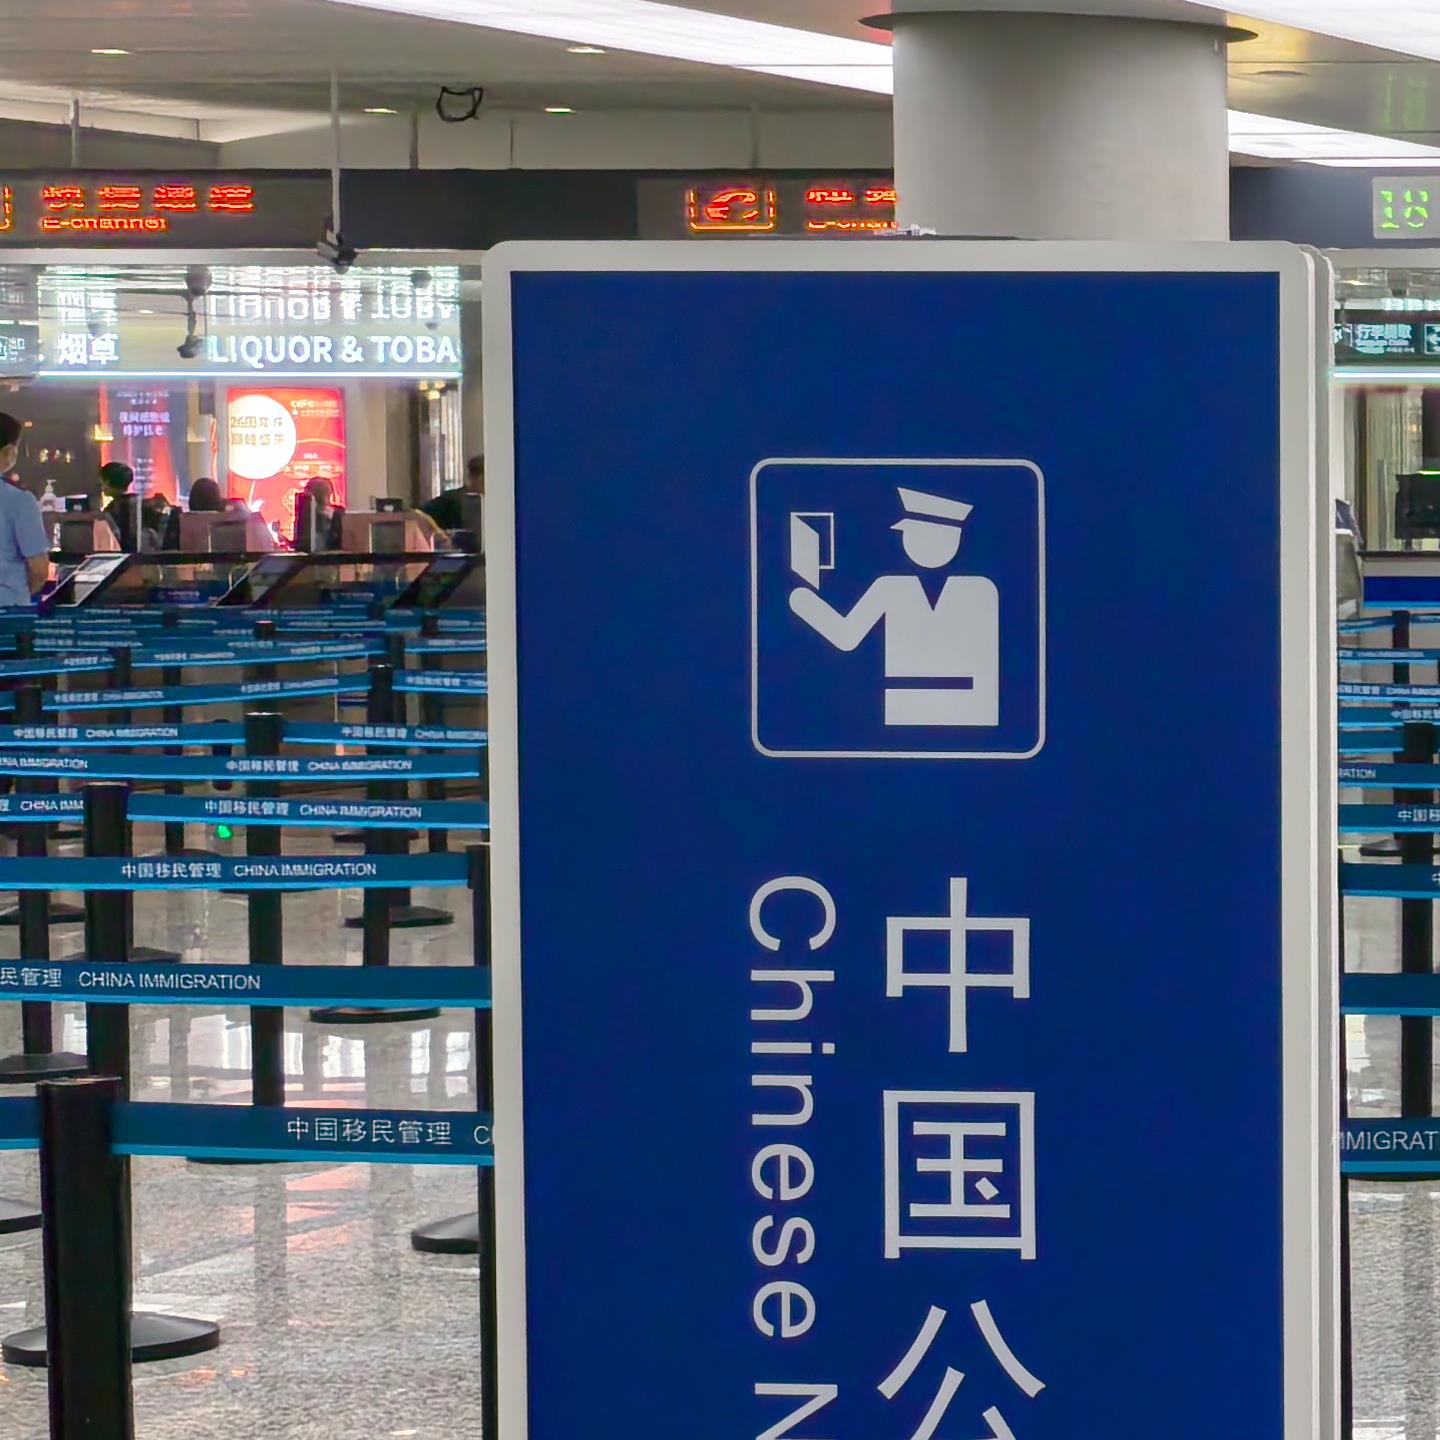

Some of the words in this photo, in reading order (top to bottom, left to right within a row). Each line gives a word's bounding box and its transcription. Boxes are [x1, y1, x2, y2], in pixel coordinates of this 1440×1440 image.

[210, 336, 332, 368] LIQUOR
[342, 335, 363, 363] &
[370, 336, 458, 363] TOBA
[205, 800, 289, 815] 中国移民管理
[300, 804, 338, 815] CHINA
[122, 863, 221, 878] 中国移民管理
[234, 865, 279, 876] CHINA
[281, 863, 376, 876] IMMIGRATION
[79, 972, 135, 987] CHINA
[140, 974, 260, 989] IMMIGRATION
[747, 874, 838, 1340] Chinese
[288, 1118, 451, 1144] 中国移民管理
